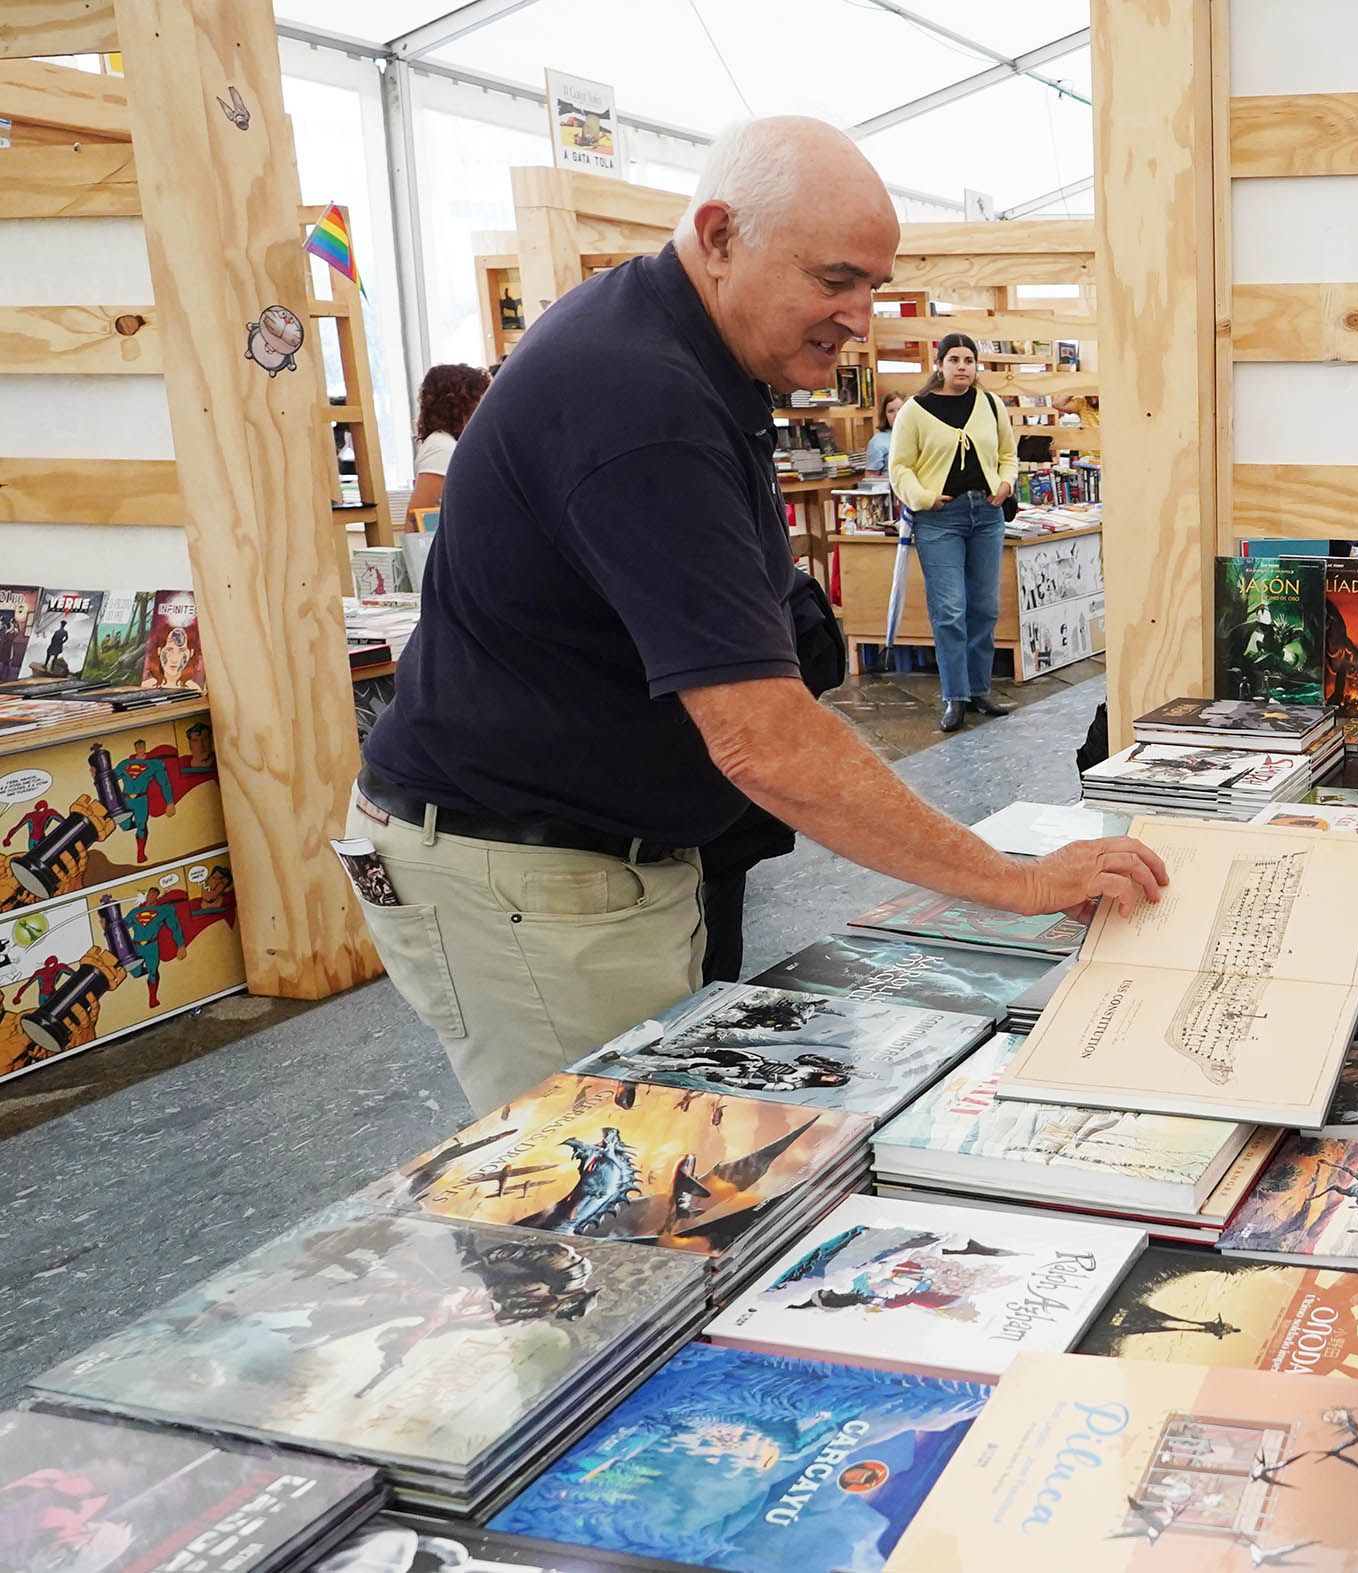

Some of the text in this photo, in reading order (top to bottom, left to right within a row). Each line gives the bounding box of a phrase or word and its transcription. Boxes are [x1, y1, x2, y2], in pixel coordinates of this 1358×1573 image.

[49, 597, 91, 610] VERNE
[1239, 575, 1300, 595] JASÓN
[847, 952, 924, 999] MAGNU
[870, 954, 945, 1002] KAROLU
[1119, 978, 1134, 995] USS
[1080, 993, 1123, 1059] CONSTITUTION
[1034, 1249, 1097, 1294] Ralph
[764, 1419, 871, 1528] CARCAYÚ
[1022, 1398, 1131, 1536] Piluca
